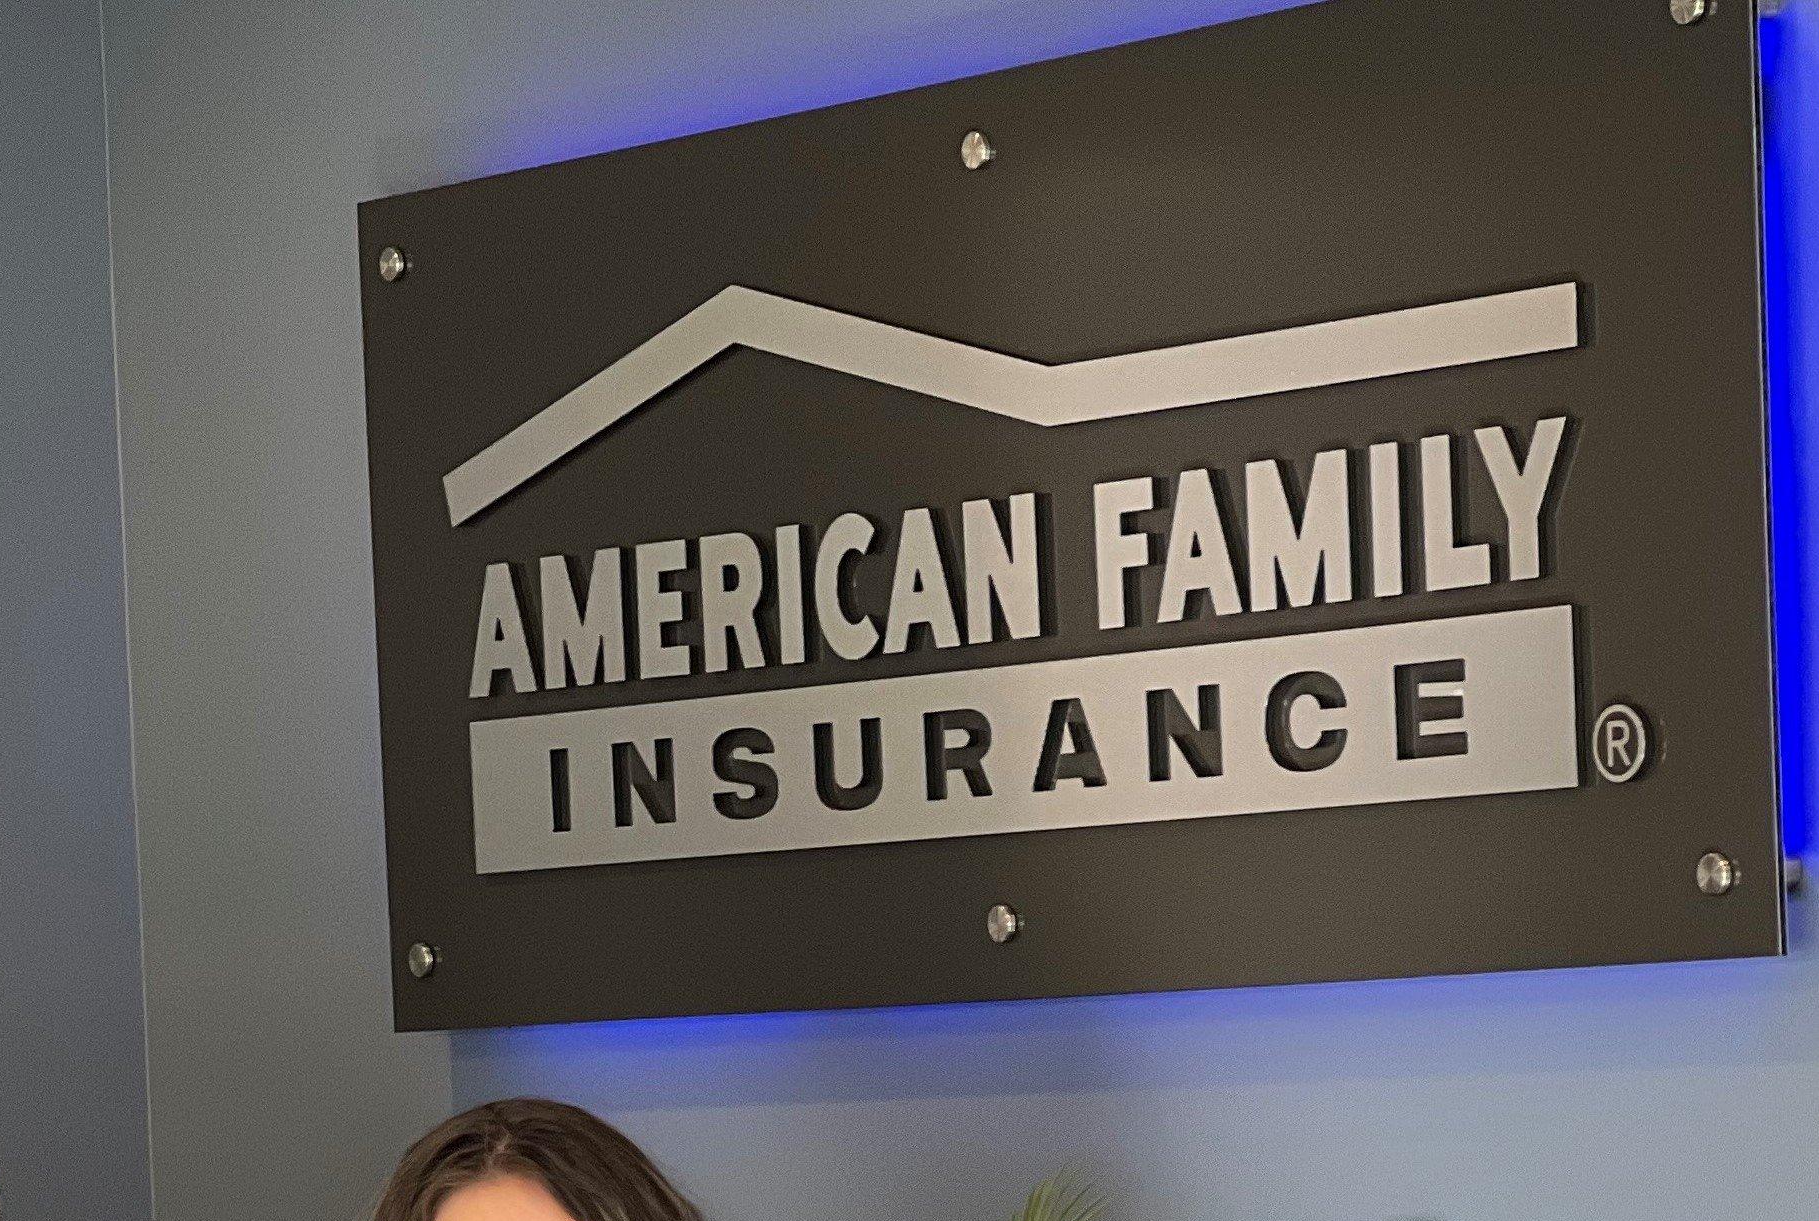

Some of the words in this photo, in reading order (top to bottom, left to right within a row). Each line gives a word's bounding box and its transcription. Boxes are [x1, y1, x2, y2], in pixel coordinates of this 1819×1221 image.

[468, 491, 1044, 700] AMERICAN
[1092, 415, 1567, 634] FAMILY
[547, 658, 1470, 834] INSURANCE
